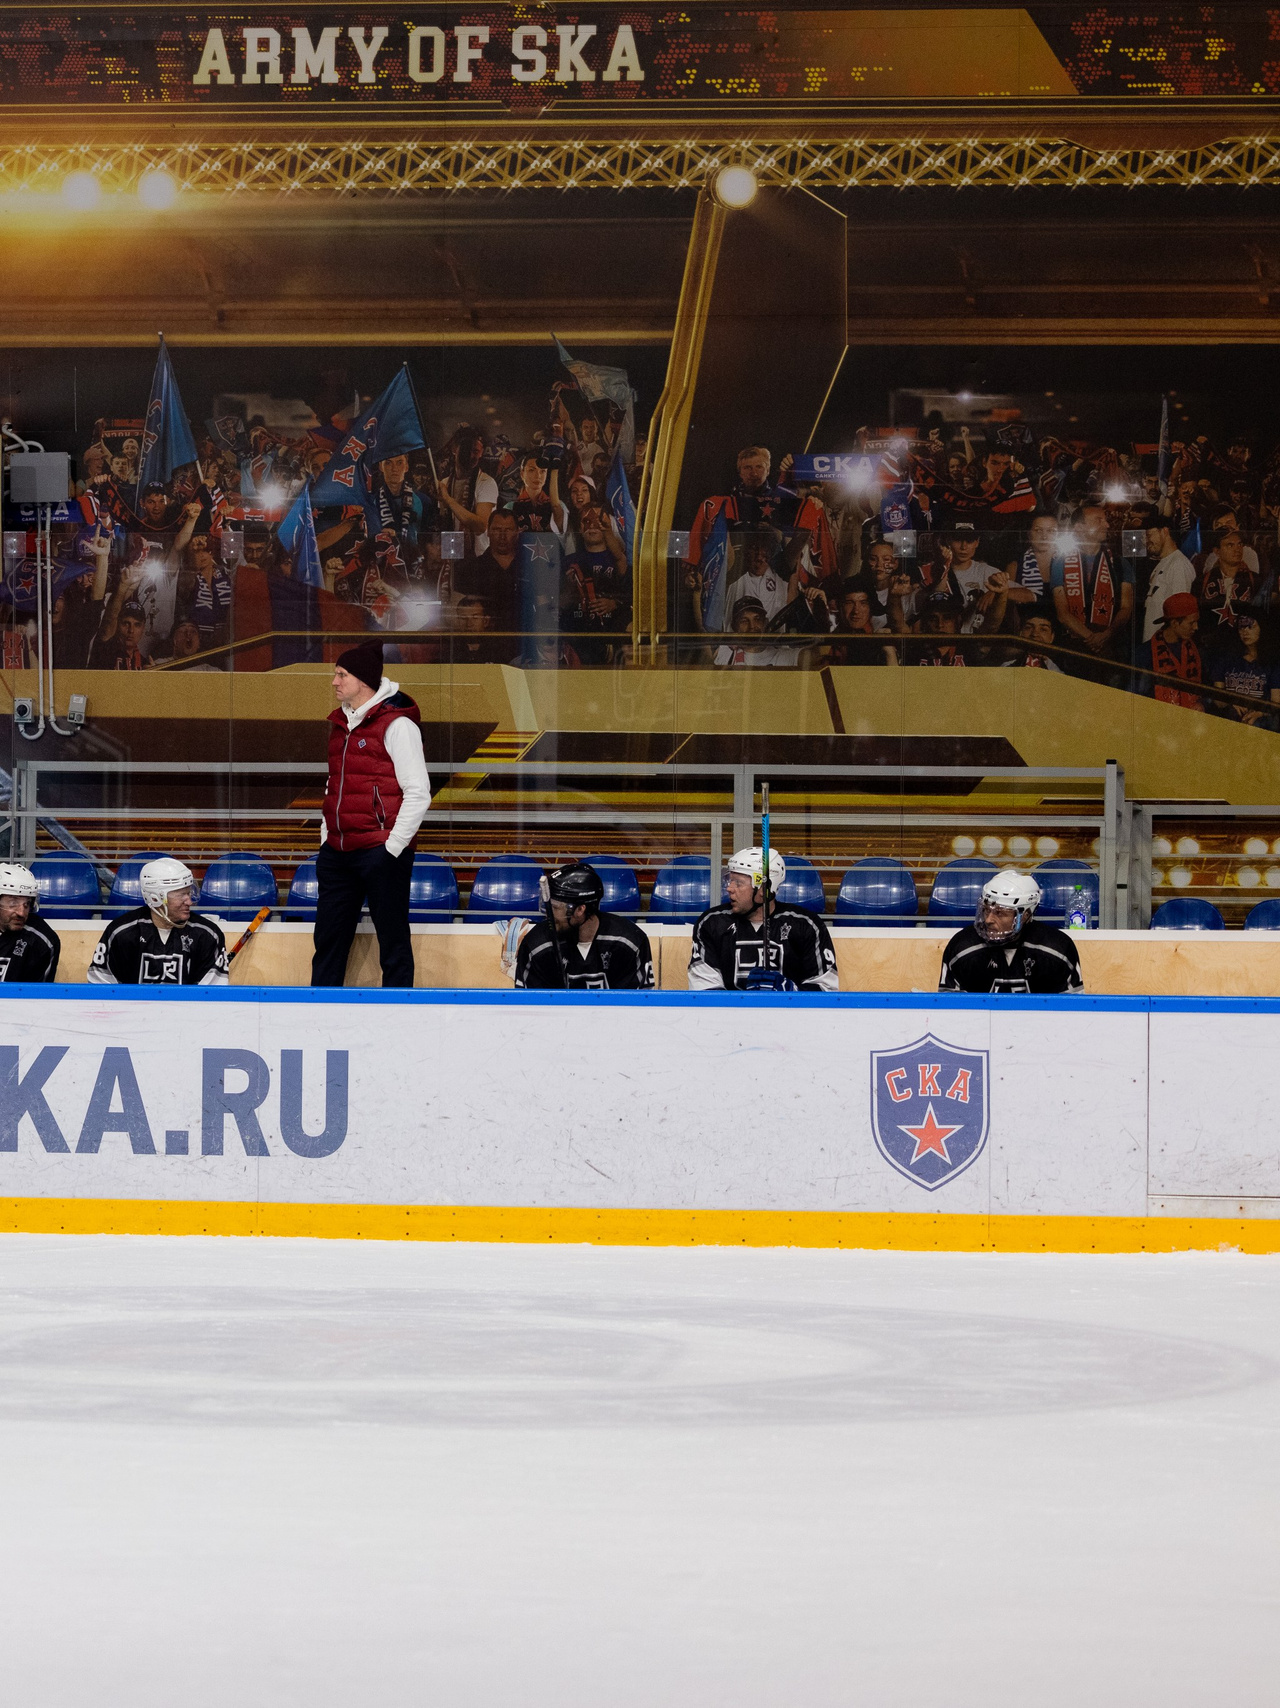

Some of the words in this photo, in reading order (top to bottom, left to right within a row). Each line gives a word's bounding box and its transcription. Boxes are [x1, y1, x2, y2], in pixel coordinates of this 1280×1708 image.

[193, 26, 388, 84] ARMY
[409, 26, 489, 83] OF
[511, 25, 645, 82] SKA
[813, 456, 873, 472] СКА
[1065, 549, 1079, 568] IC
[737, 948, 778, 967] LR
[144, 960, 178, 980] LR
[885, 1064, 973, 1104] СКА
